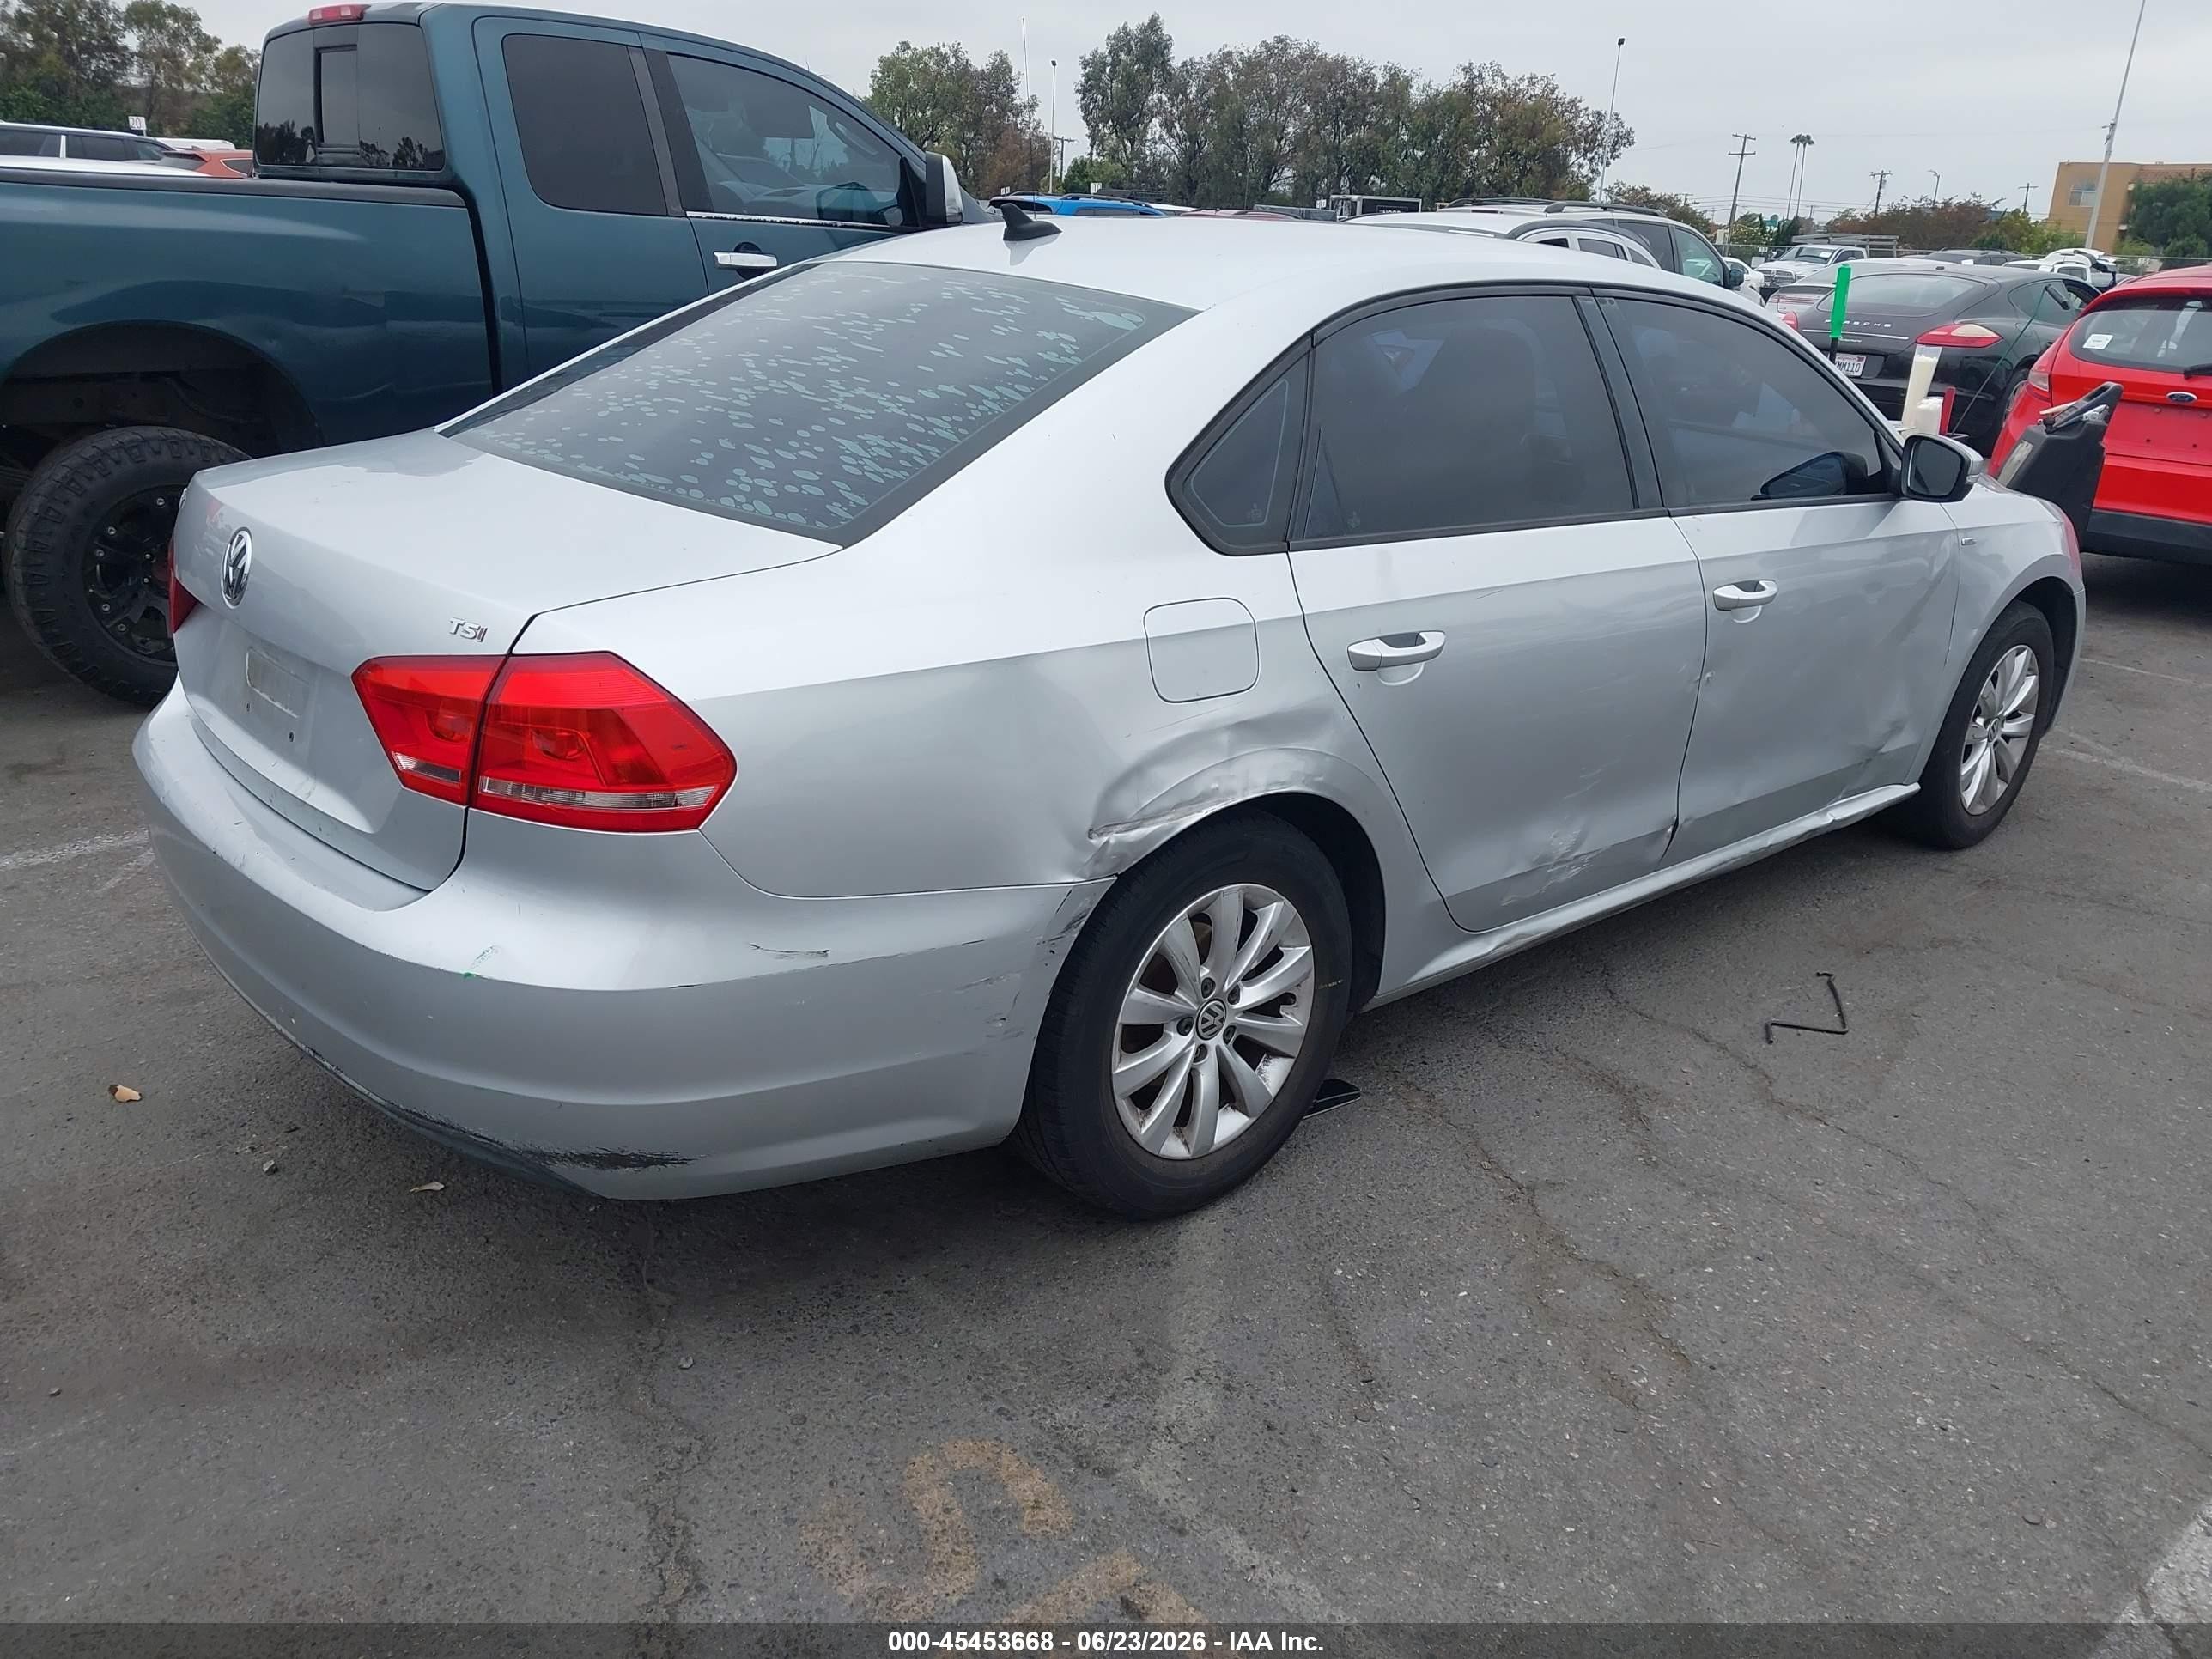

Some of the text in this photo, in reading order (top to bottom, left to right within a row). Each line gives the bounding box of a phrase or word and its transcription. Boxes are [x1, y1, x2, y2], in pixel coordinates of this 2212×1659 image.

[130, 117, 142, 129] 20
[1825, 319, 1892, 328] PRSCHE
[1835, 361, 1861, 373] MM110
